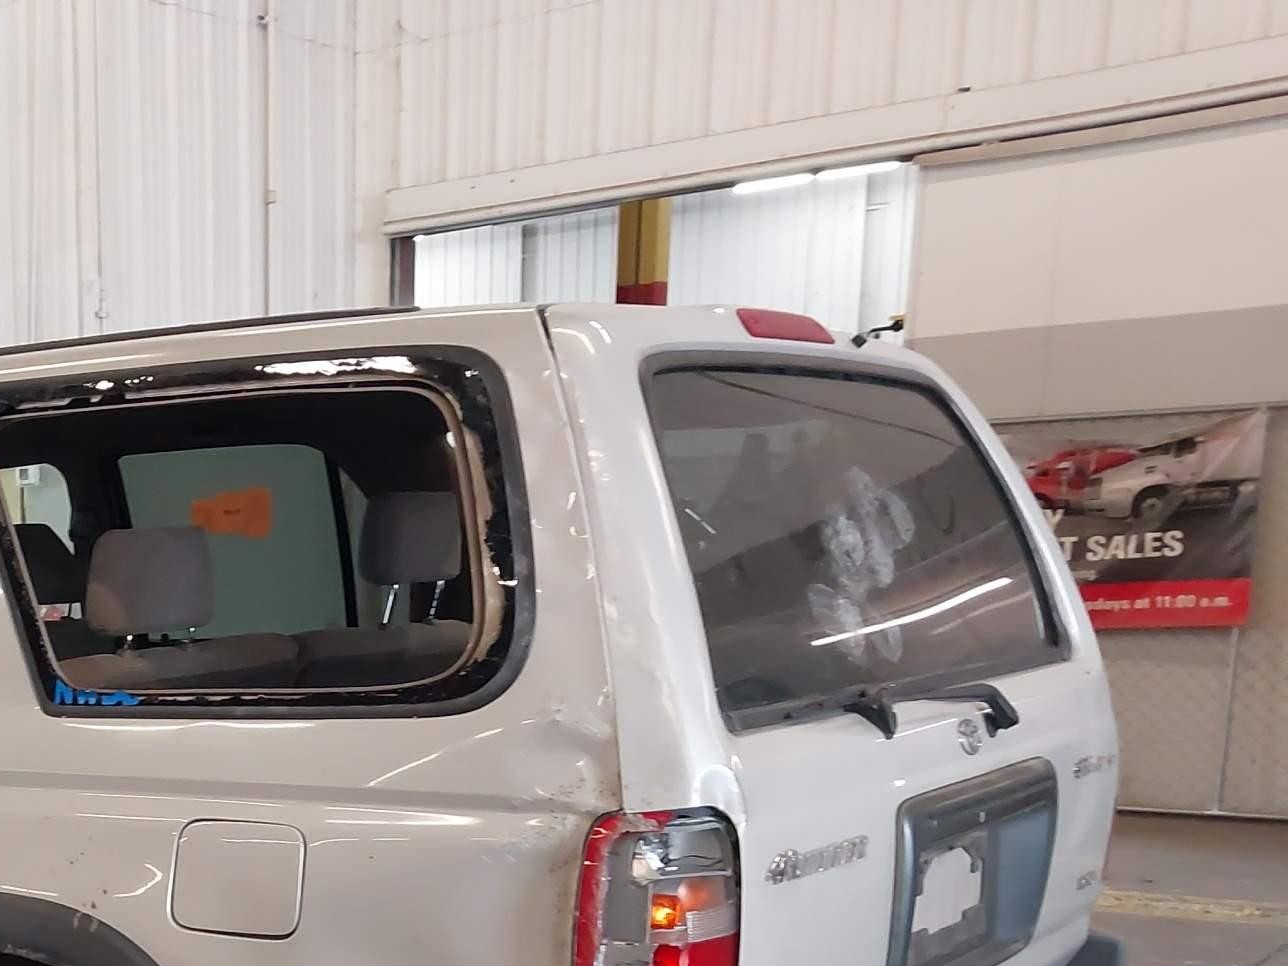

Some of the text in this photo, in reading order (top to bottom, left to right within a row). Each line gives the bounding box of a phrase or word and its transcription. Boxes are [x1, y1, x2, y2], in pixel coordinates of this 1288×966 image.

[1086, 530, 1185, 561] SALES
[1133, 597, 1150, 609] at
[1155, 594, 1196, 609] 11:00
